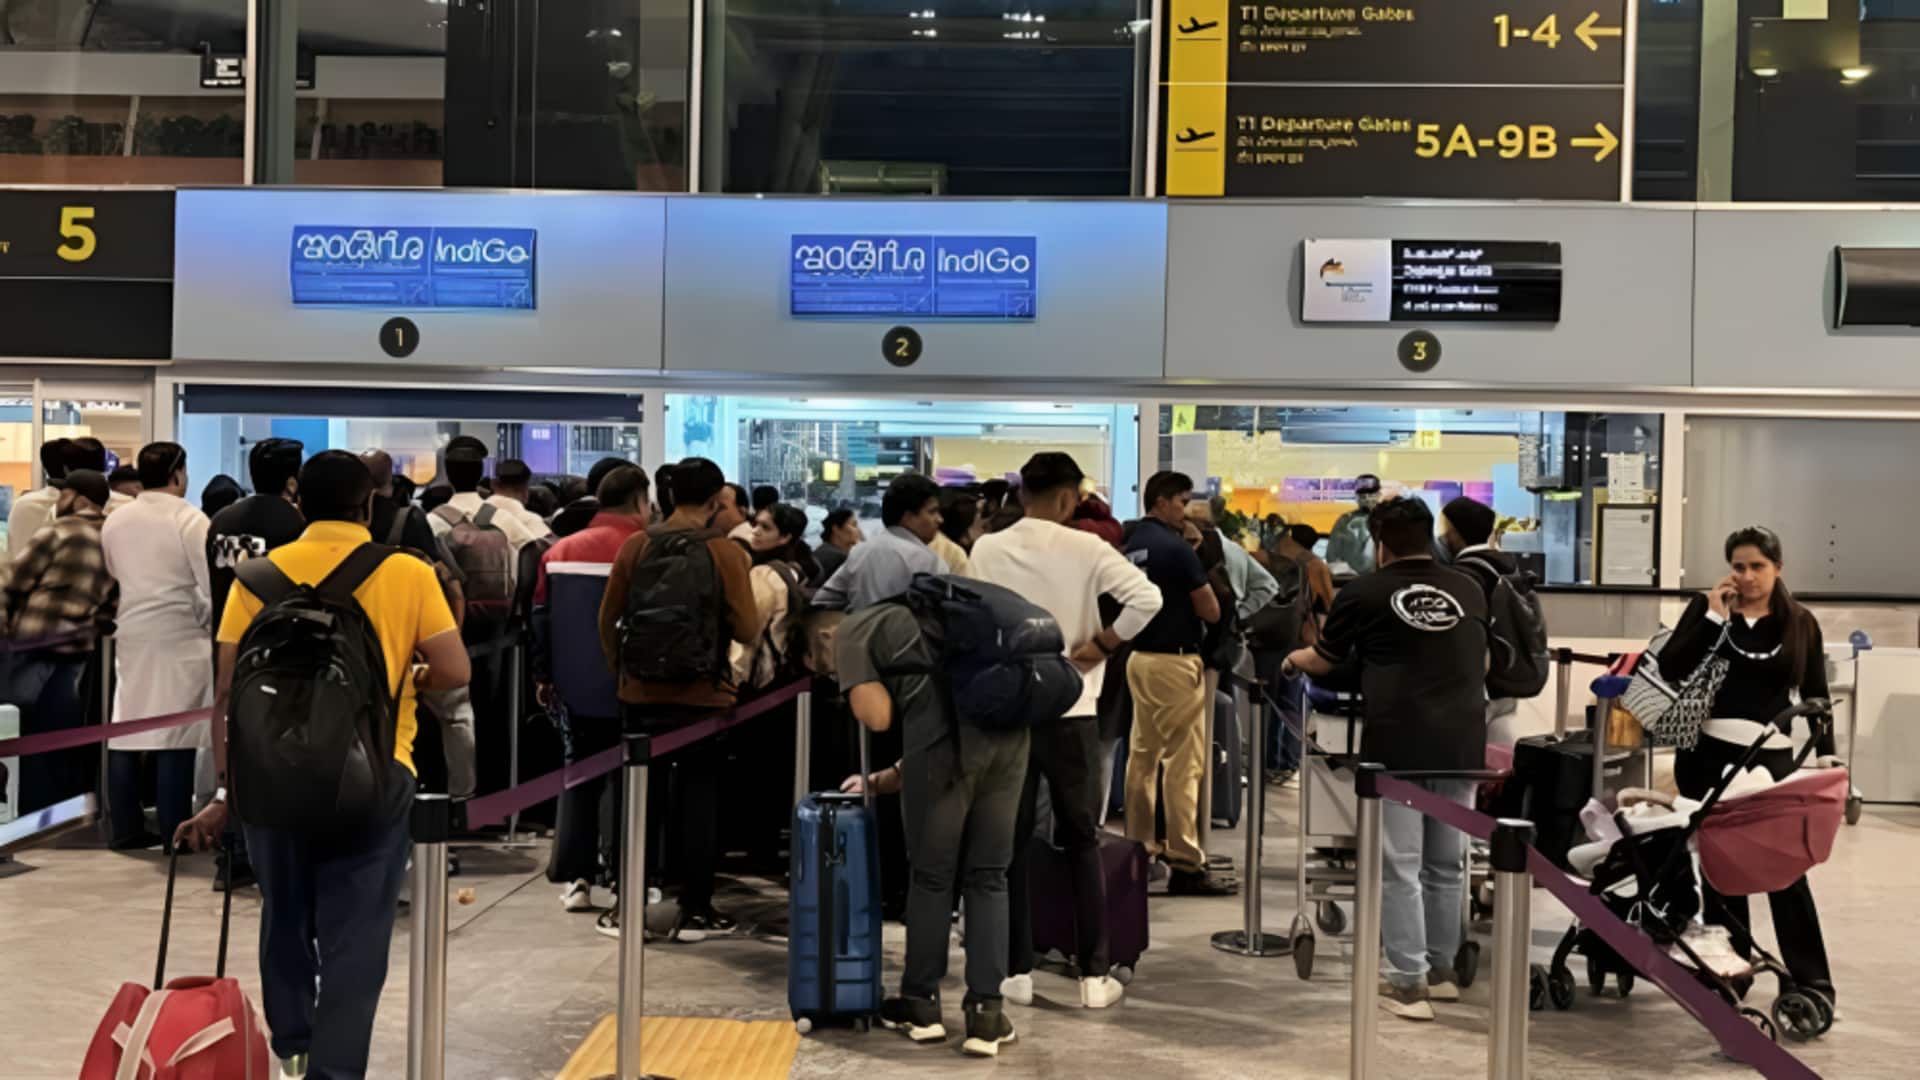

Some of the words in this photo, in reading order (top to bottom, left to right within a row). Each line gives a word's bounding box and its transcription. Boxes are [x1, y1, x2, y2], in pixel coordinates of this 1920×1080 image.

[1240, 5, 1258, 21] T1
[1264, 6, 1356, 23] Departure
[1361, 6, 1415, 21] Gates
[1494, 13, 1561, 48] 1-4
[1237, 116, 1255, 131] T1
[1261, 116, 1354, 133] Departure
[1358, 116, 1412, 132] Gates
[1415, 123, 1557, 159] 5A-9B
[57, 206, 97, 261] 5
[434, 236, 528, 263] IndiGo
[936, 247, 1030, 273] IndiGo
[894, 336, 910, 357] 2
[1412, 340, 1428, 361] 3
